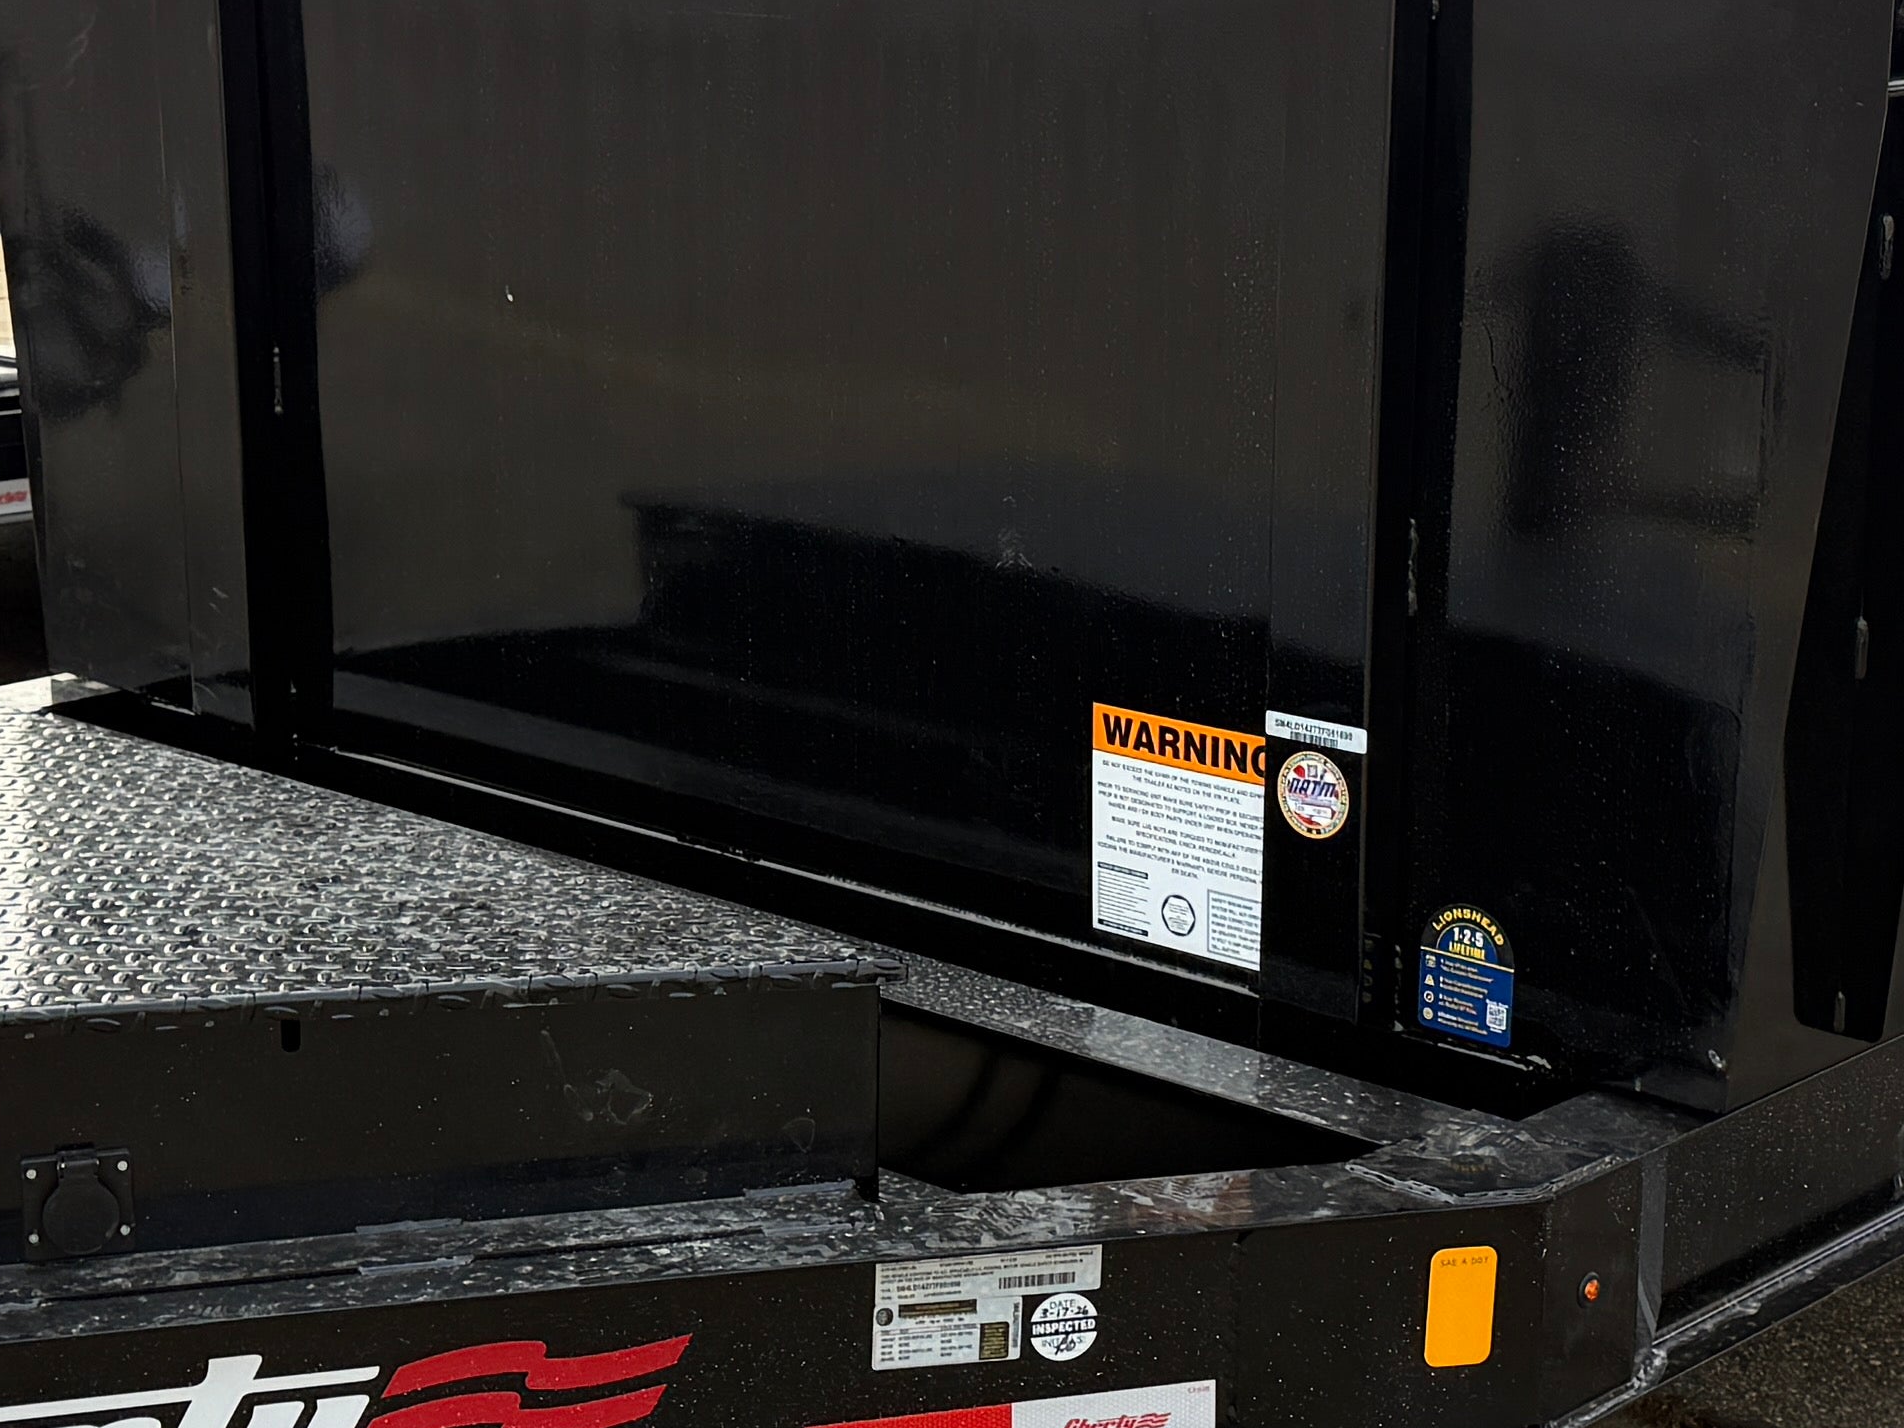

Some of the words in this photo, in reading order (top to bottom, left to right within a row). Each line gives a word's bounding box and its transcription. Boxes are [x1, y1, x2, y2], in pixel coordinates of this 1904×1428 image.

[1432, 908, 1504, 946] LIONSHEAD
[1049, 1299, 1075, 1310] DATE
[1032, 1318, 1096, 1335] INSPECTED
